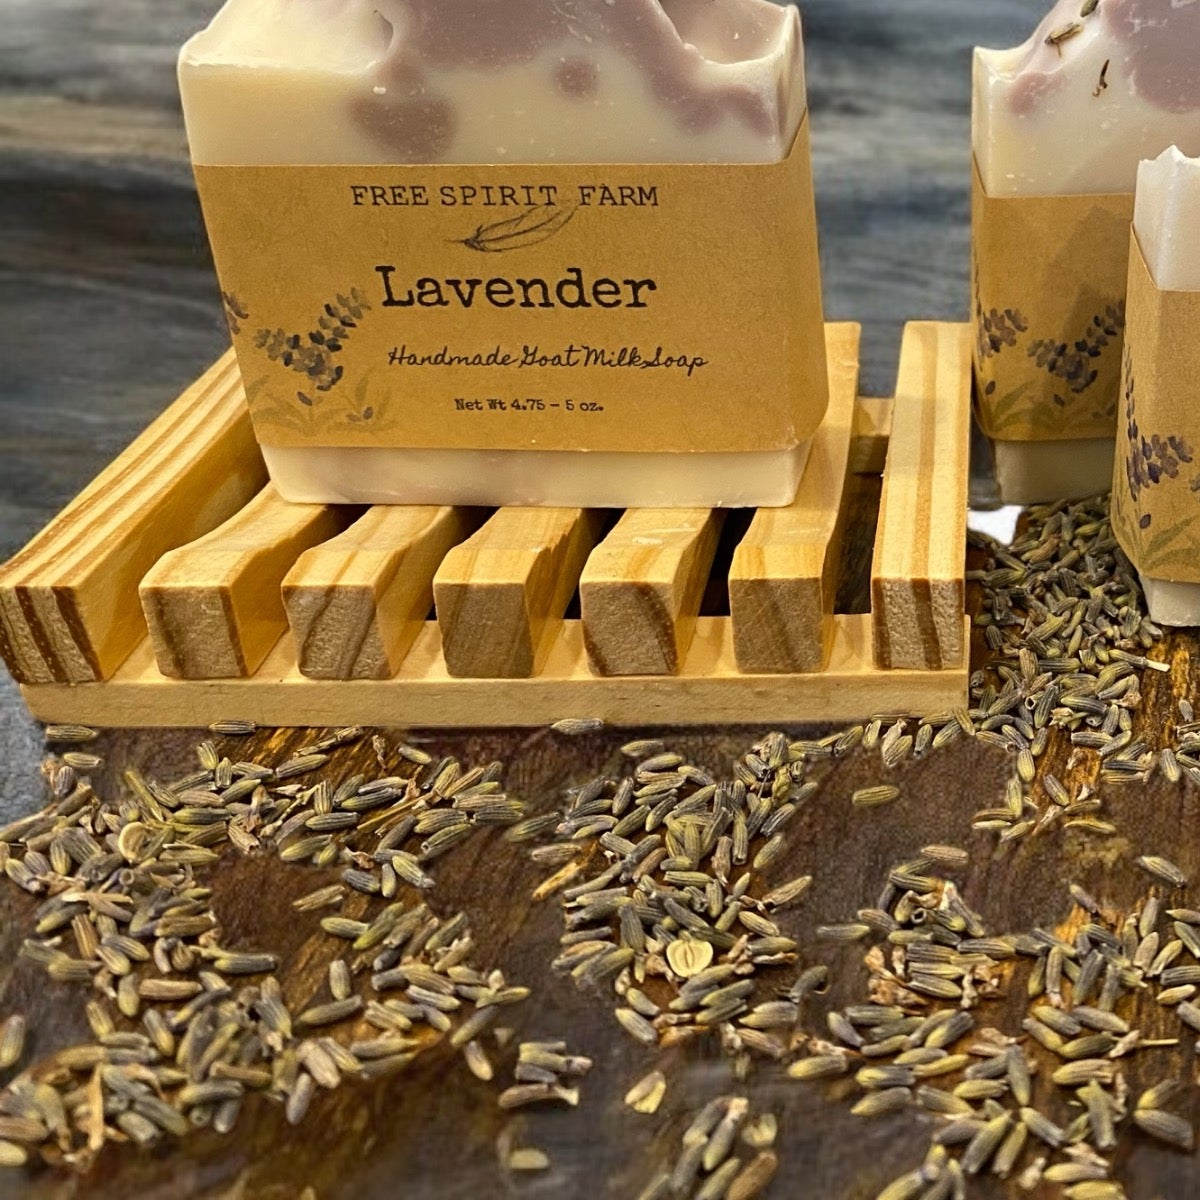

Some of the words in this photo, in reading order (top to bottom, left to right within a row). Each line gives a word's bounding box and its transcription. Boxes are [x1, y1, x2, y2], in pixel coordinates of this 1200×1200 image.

[350, 185, 429, 206] FREE
[440, 185, 557, 207] SPIRIT
[578, 185, 660, 207] FARM
[374, 266, 656, 309] Lavender
[389, 346, 518, 368] Handmade
[518, 345, 579, 369] Goat
[581, 346, 645, 368] Milk
[641, 348, 708, 377] Soap
[454, 399, 483, 412] Net
[487, 399, 508, 412] Wt
[511, 399, 546, 412] 4.75
[565, 399, 575, 412] 5
[579, 402, 604, 412] oz.
